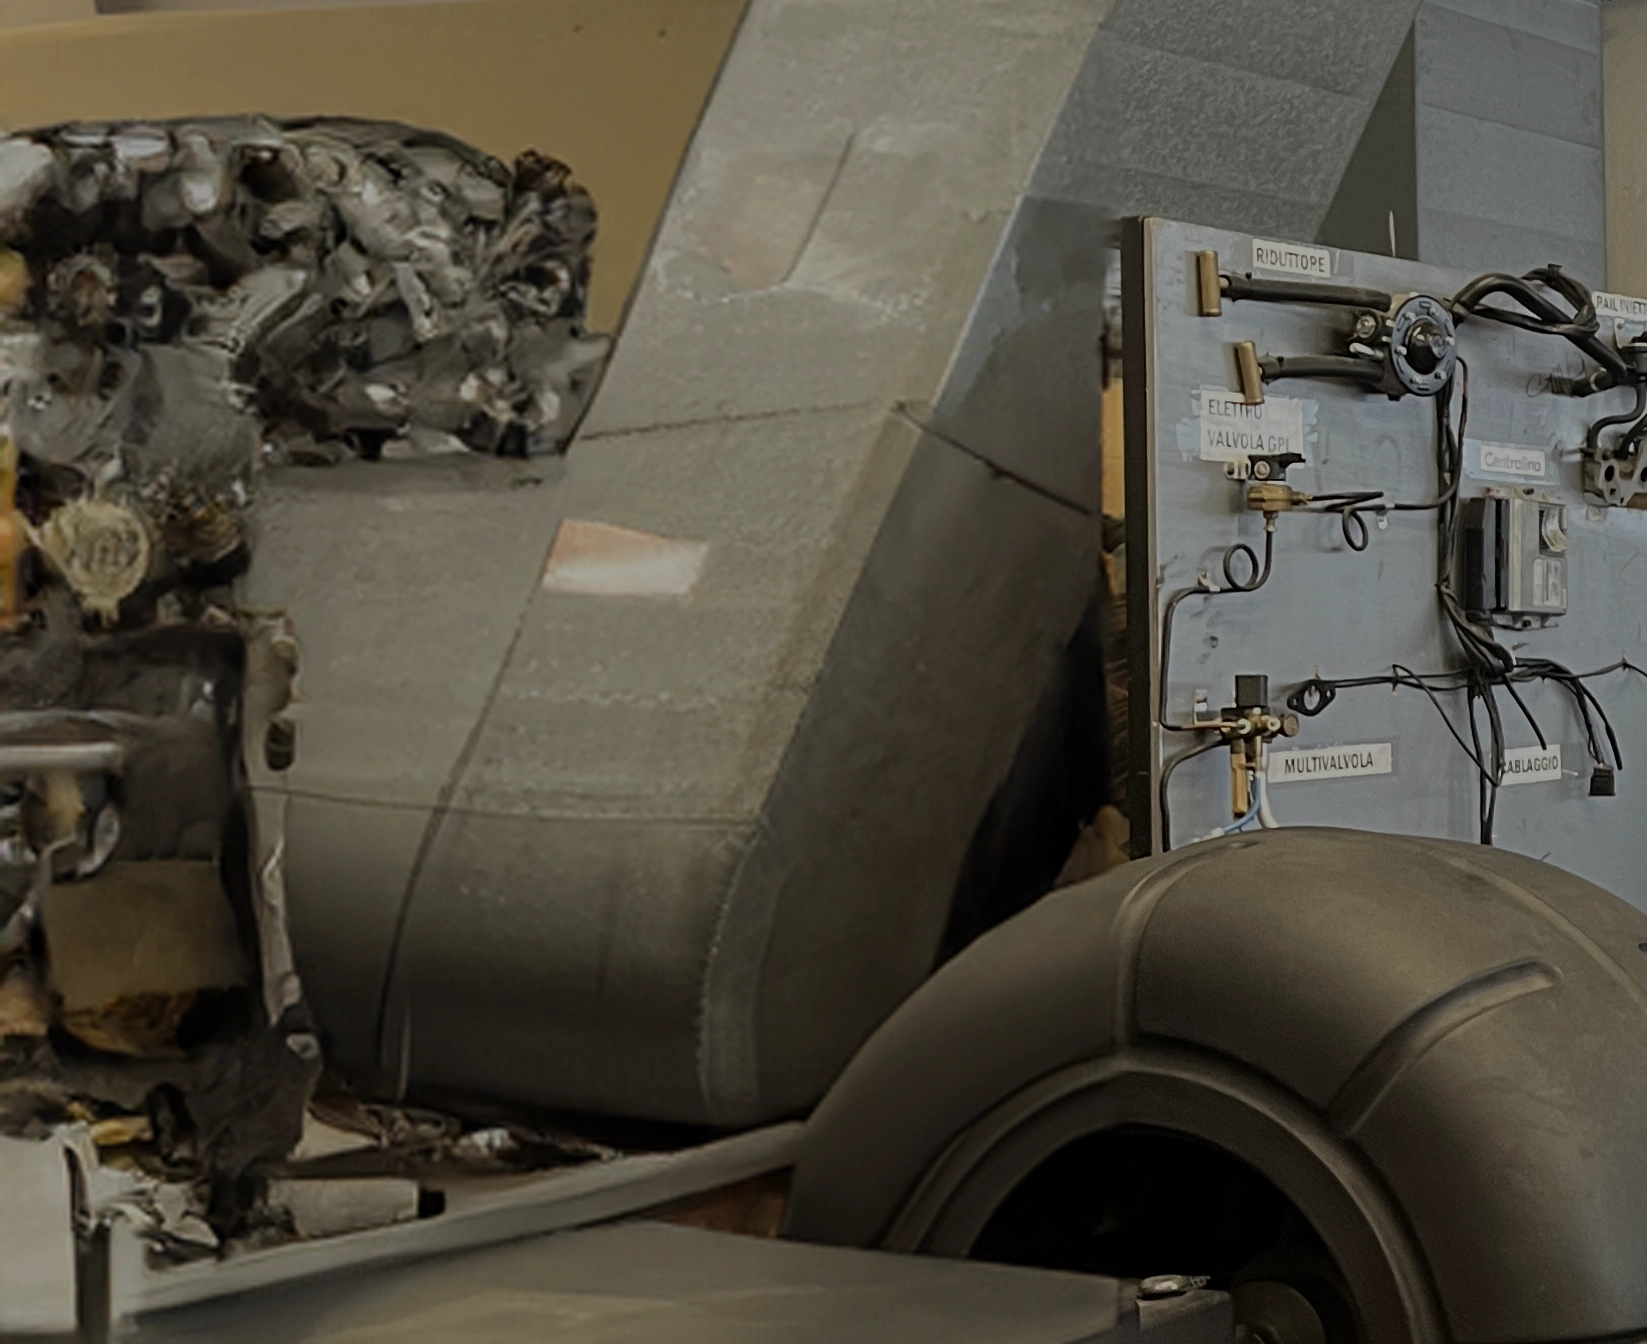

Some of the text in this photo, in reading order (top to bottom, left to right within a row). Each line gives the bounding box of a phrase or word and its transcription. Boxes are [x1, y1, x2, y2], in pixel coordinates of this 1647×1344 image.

[1256, 247, 1326, 273] RIDUTTORE
[1207, 429, 1264, 450] VALVOLA
[1284, 752, 1374, 775] MULTIVALVOLA
